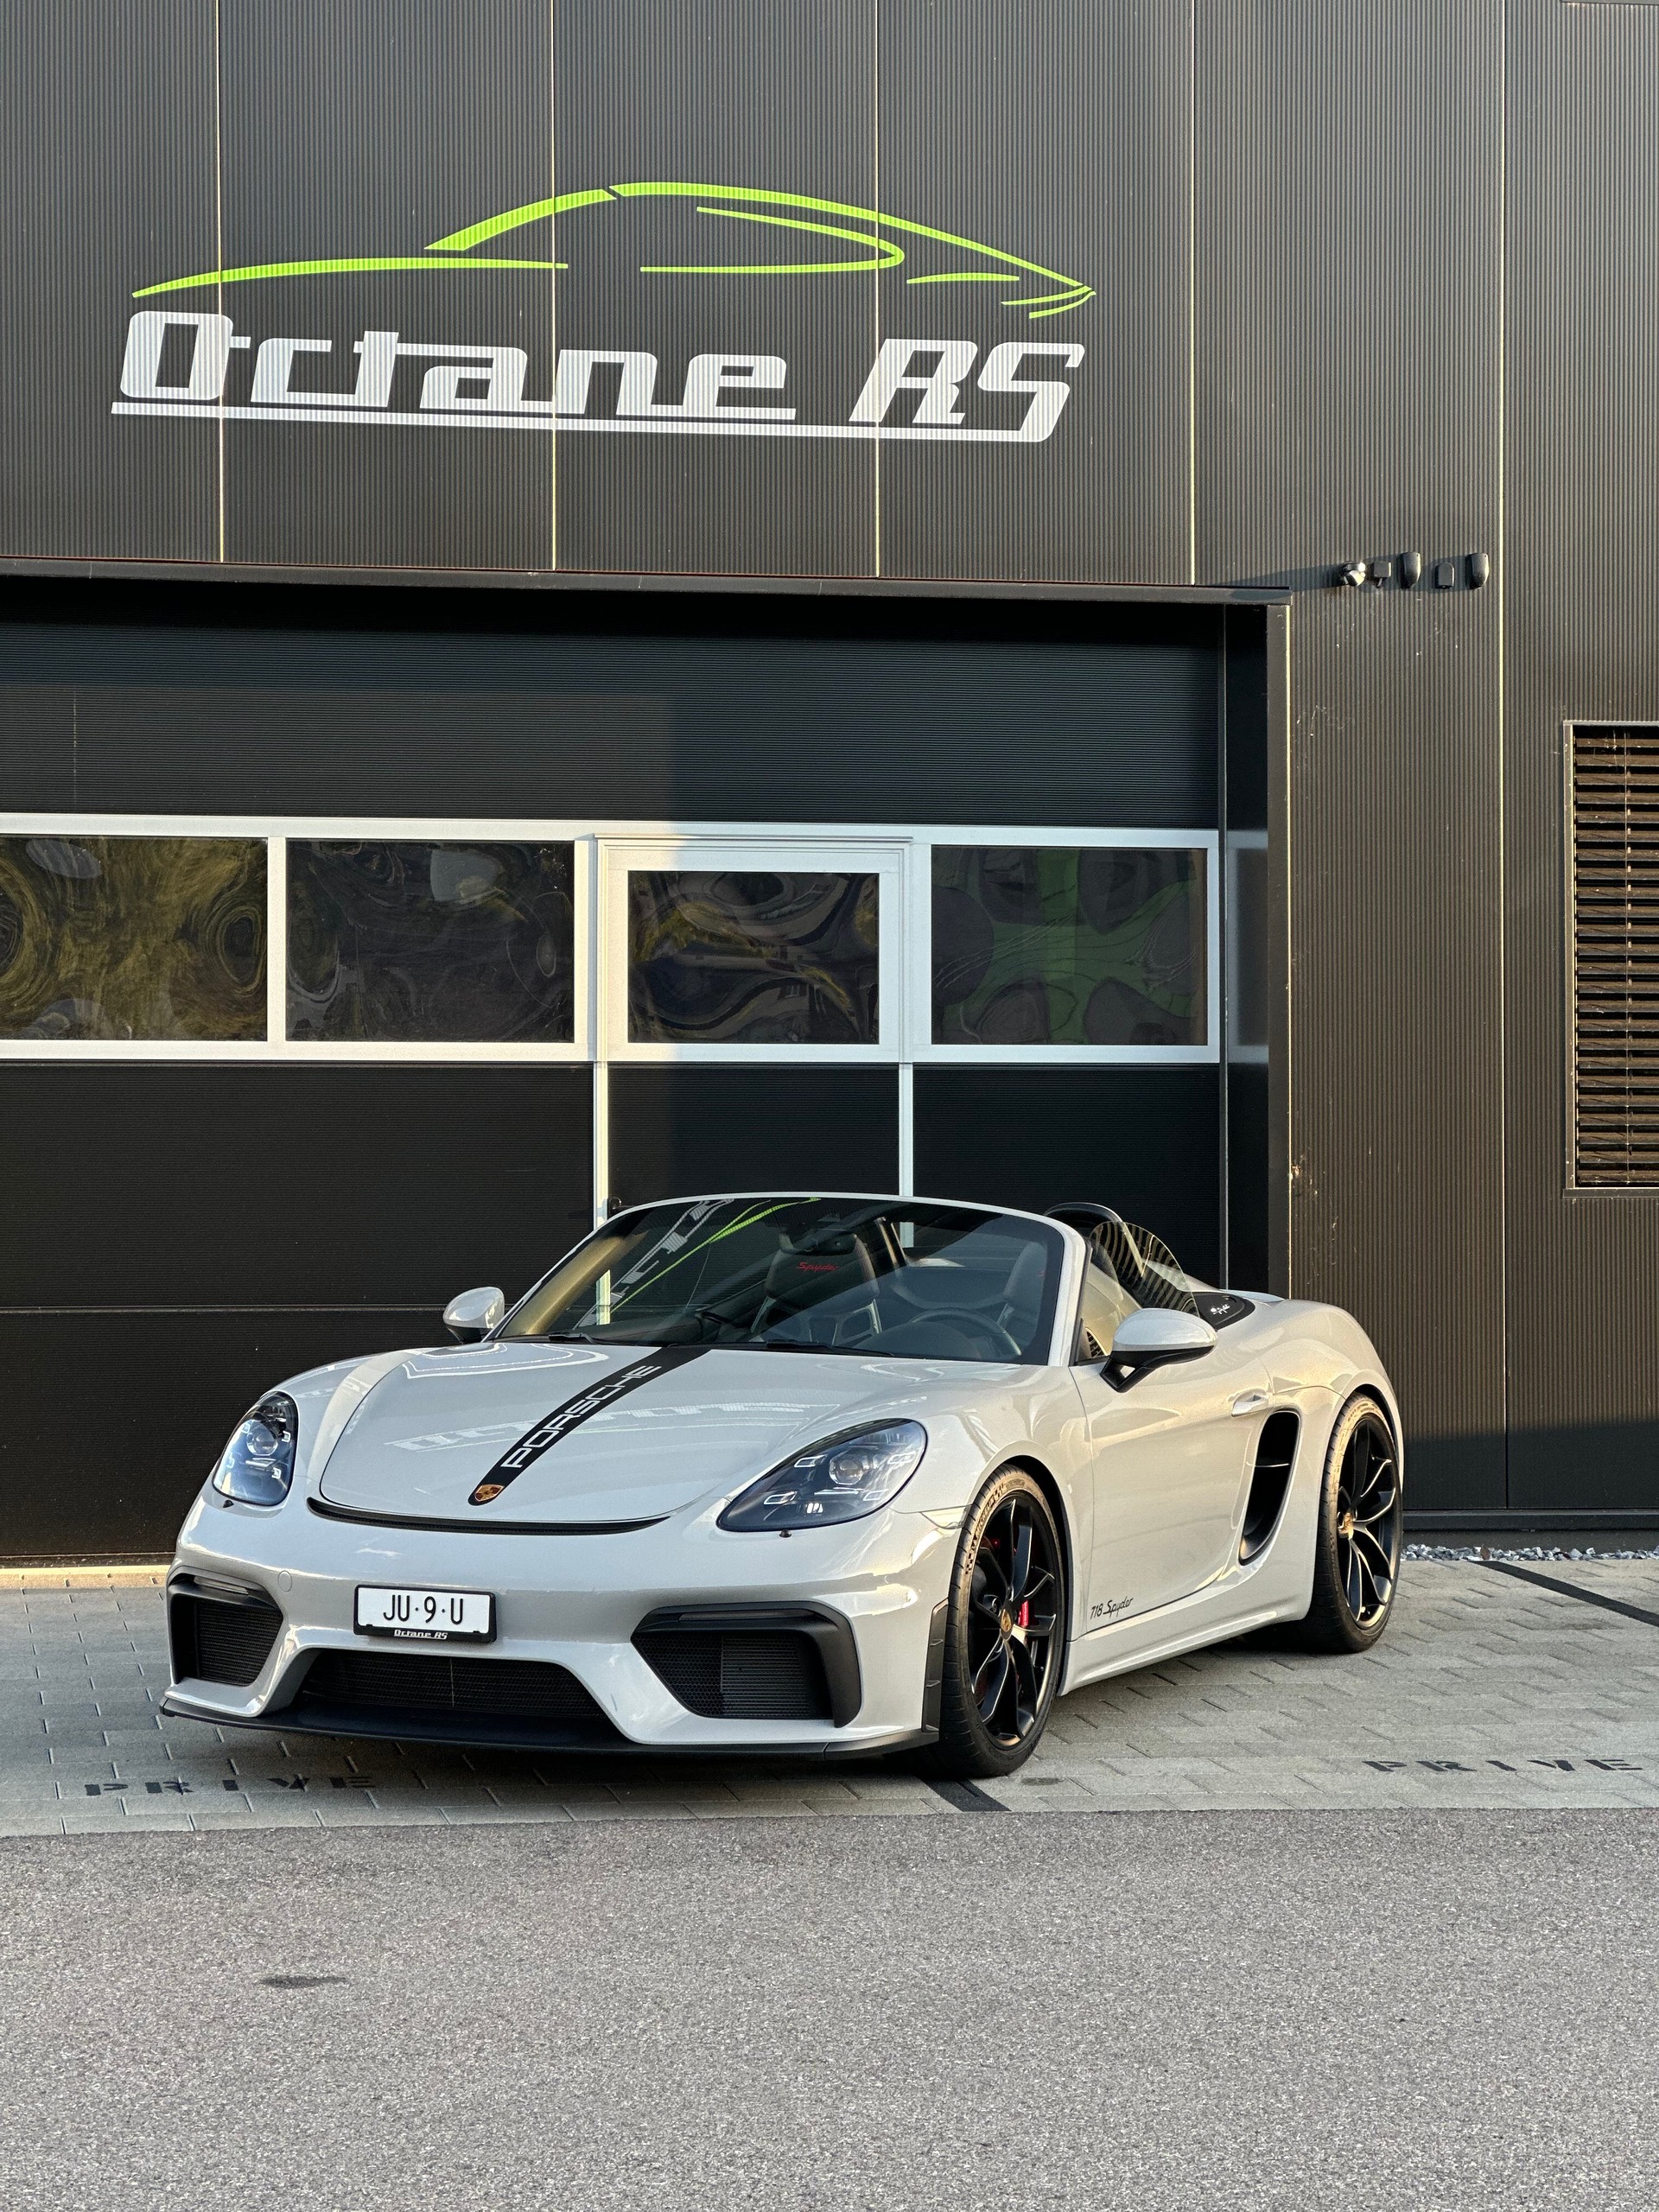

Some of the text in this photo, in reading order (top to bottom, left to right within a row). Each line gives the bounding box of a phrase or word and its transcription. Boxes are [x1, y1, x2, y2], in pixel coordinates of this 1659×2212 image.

[120, 310, 1085, 443] Octane RS
[796, 1261, 841, 1272] Spyder
[500, 1365, 662, 1468] PORSCHE
[1090, 1596, 1134, 1619] 718 Spyder
[394, 1629, 448, 1640] Octane RS
[1362, 1759, 1643, 1771] PRIVE
[85, 1776, 376, 1796] PRIVE
